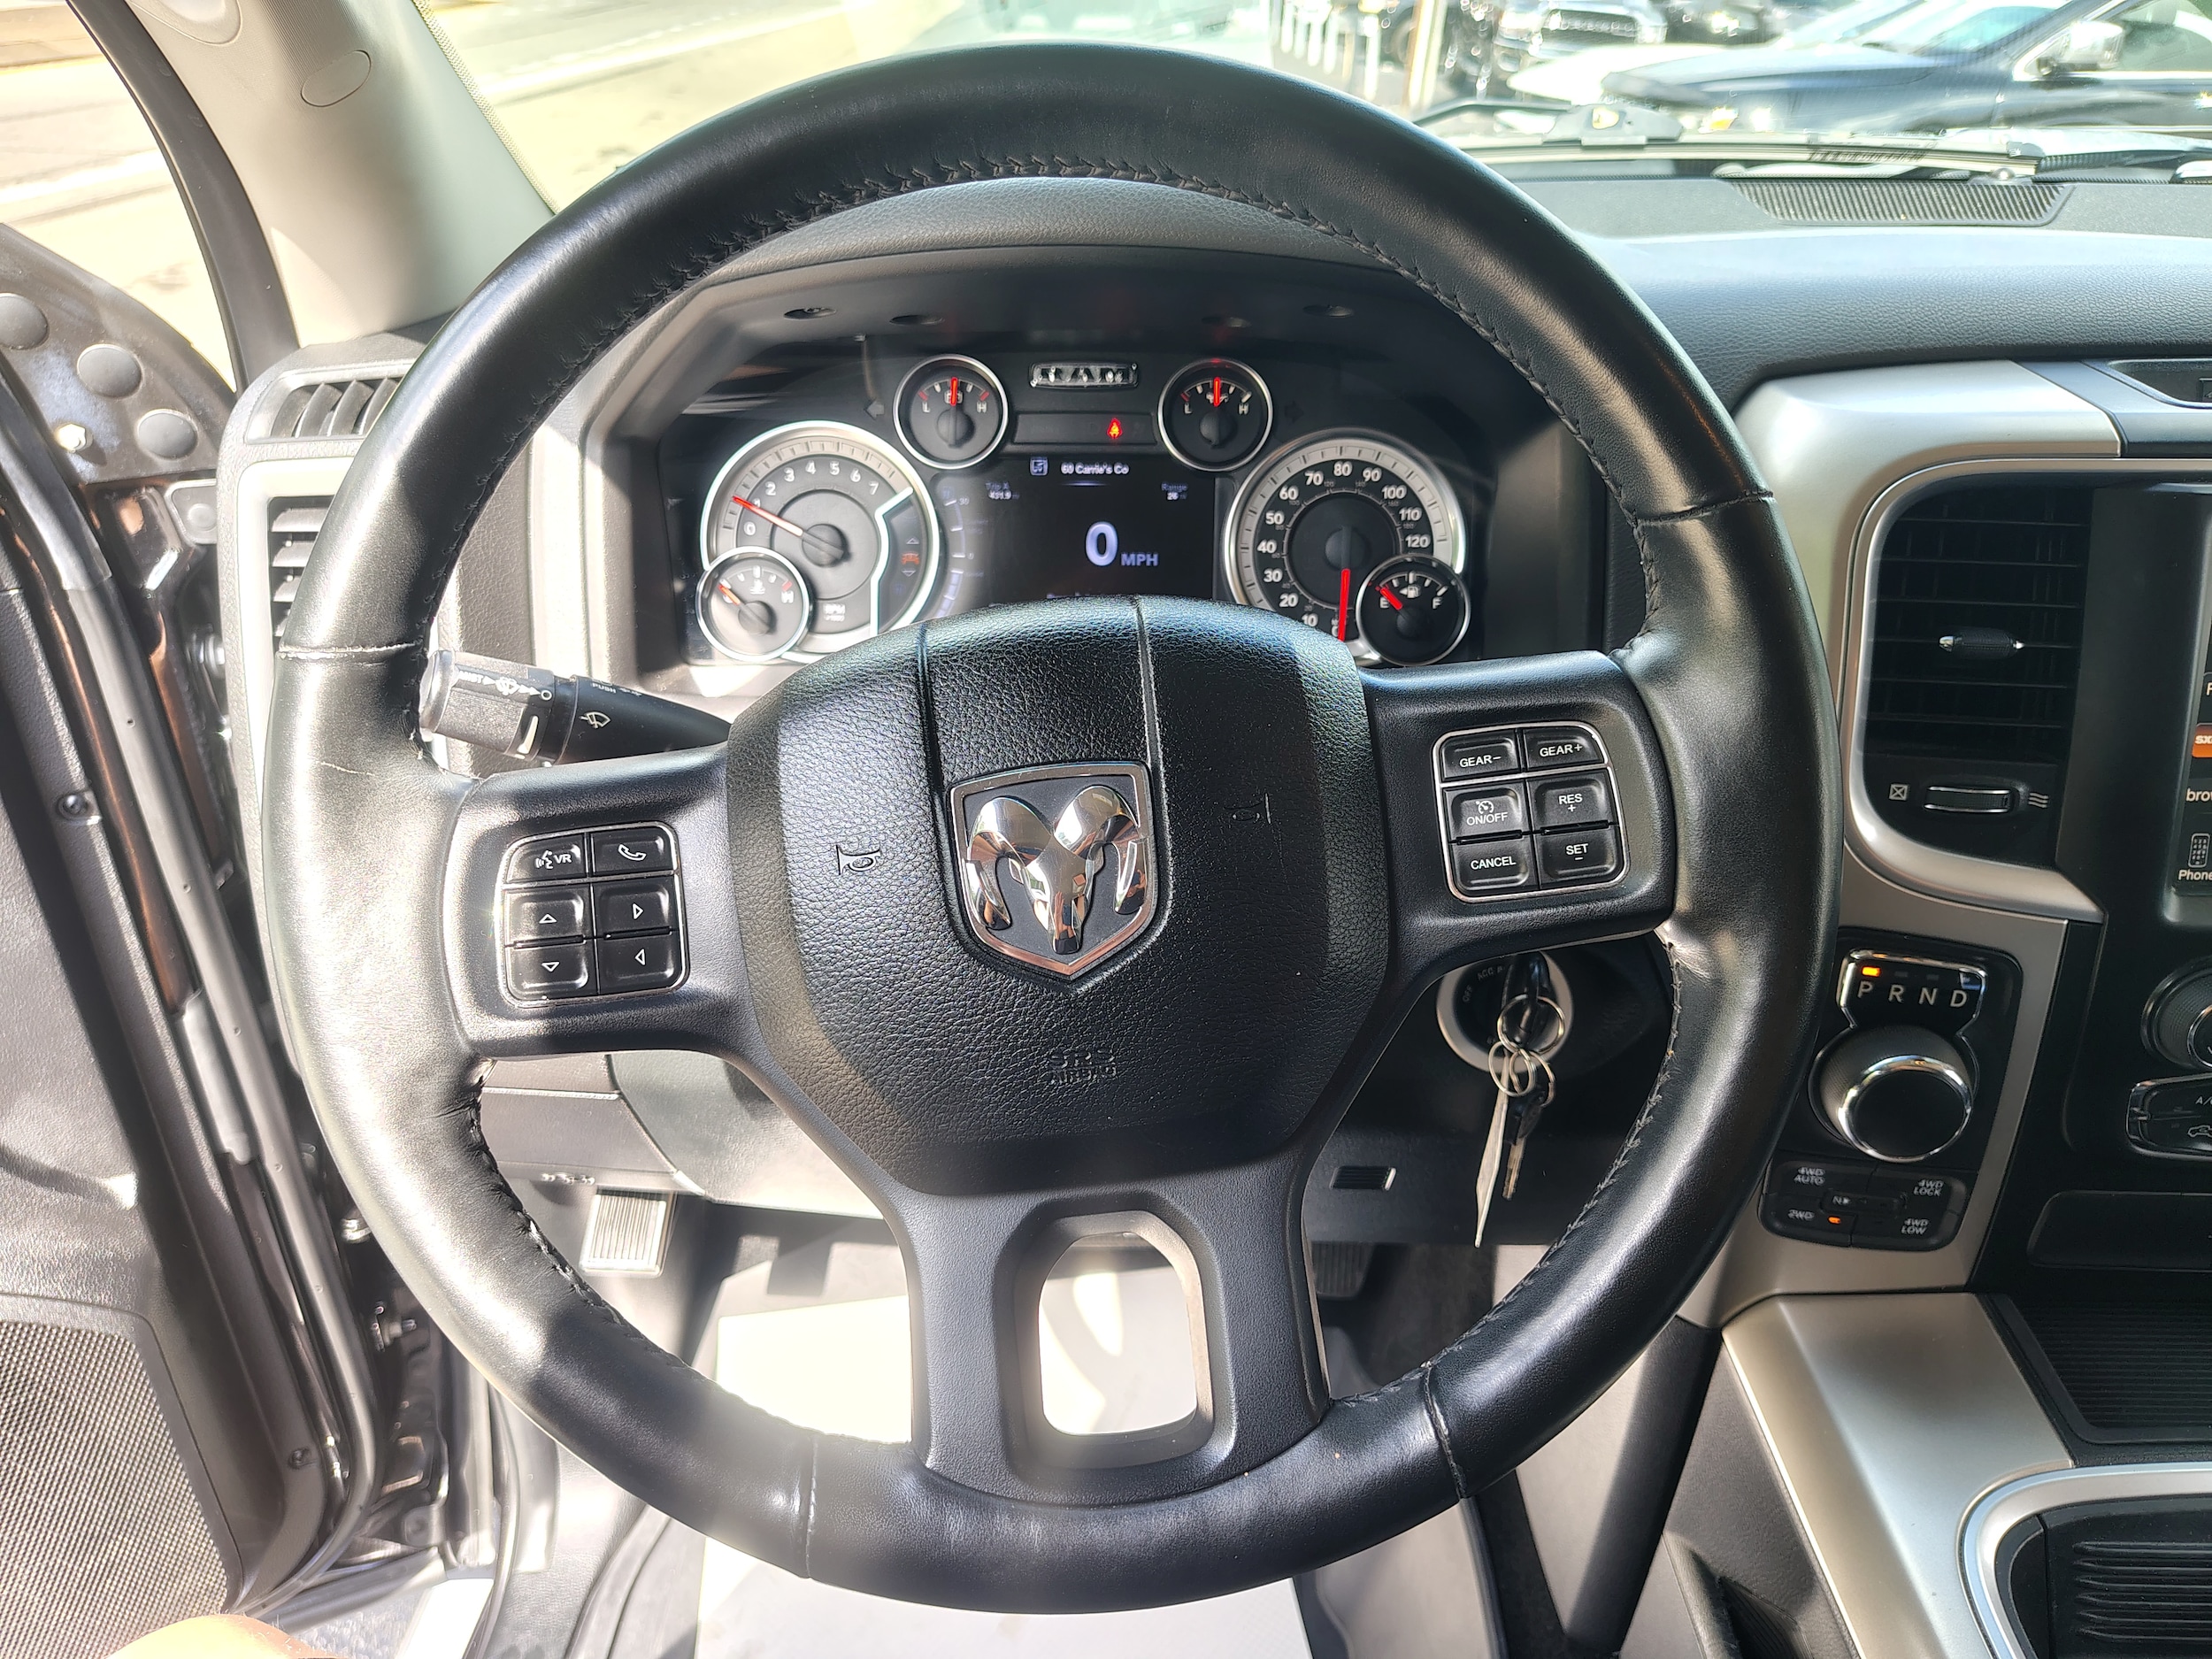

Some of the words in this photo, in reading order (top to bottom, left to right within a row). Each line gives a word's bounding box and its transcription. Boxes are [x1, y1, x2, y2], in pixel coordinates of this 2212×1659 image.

[976, 400, 987, 413] H
[1239, 402, 1249, 415] H
[784, 467, 795, 482] 3
[805, 460, 816, 475] 4
[829, 460, 840, 475] 5
[850, 468, 861, 482] 6
[1333, 460, 1353, 476] 80
[1363, 467, 1382, 482] 90
[1304, 469, 1325, 486] 70
[765, 480, 776, 495] 2
[869, 480, 879, 495] 7
[1279, 485, 1299, 501] 60
[1381, 484, 1407, 500] 100
[1265, 510, 1285, 525] 50
[1399, 507, 1422, 521] 110
[744, 521, 757, 536] 0
[1086, 521, 1118, 566] 0
[1121, 553, 1159, 566] MPH
[1256, 539, 1277, 554] 40
[1405, 534, 1431, 549] 120
[1263, 568, 1283, 583] 30
[1279, 592, 1299, 608] 20
[1432, 596, 1442, 610] F
[1302, 613, 1318, 627] 10
[592, 681, 617, 694] PUSH
[1559, 793, 1583, 805] RES
[1466, 812, 1509, 826] ON/OFF
[1566, 843, 1589, 855] SET
[555, 854, 572, 864] VR
[1471, 856, 1517, 871] CANCEL
[1858, 980, 1872, 998] P
[1888, 984, 1904, 1002] R
[1918, 987, 1937, 1006] N
[1950, 989, 1968, 1008] D
